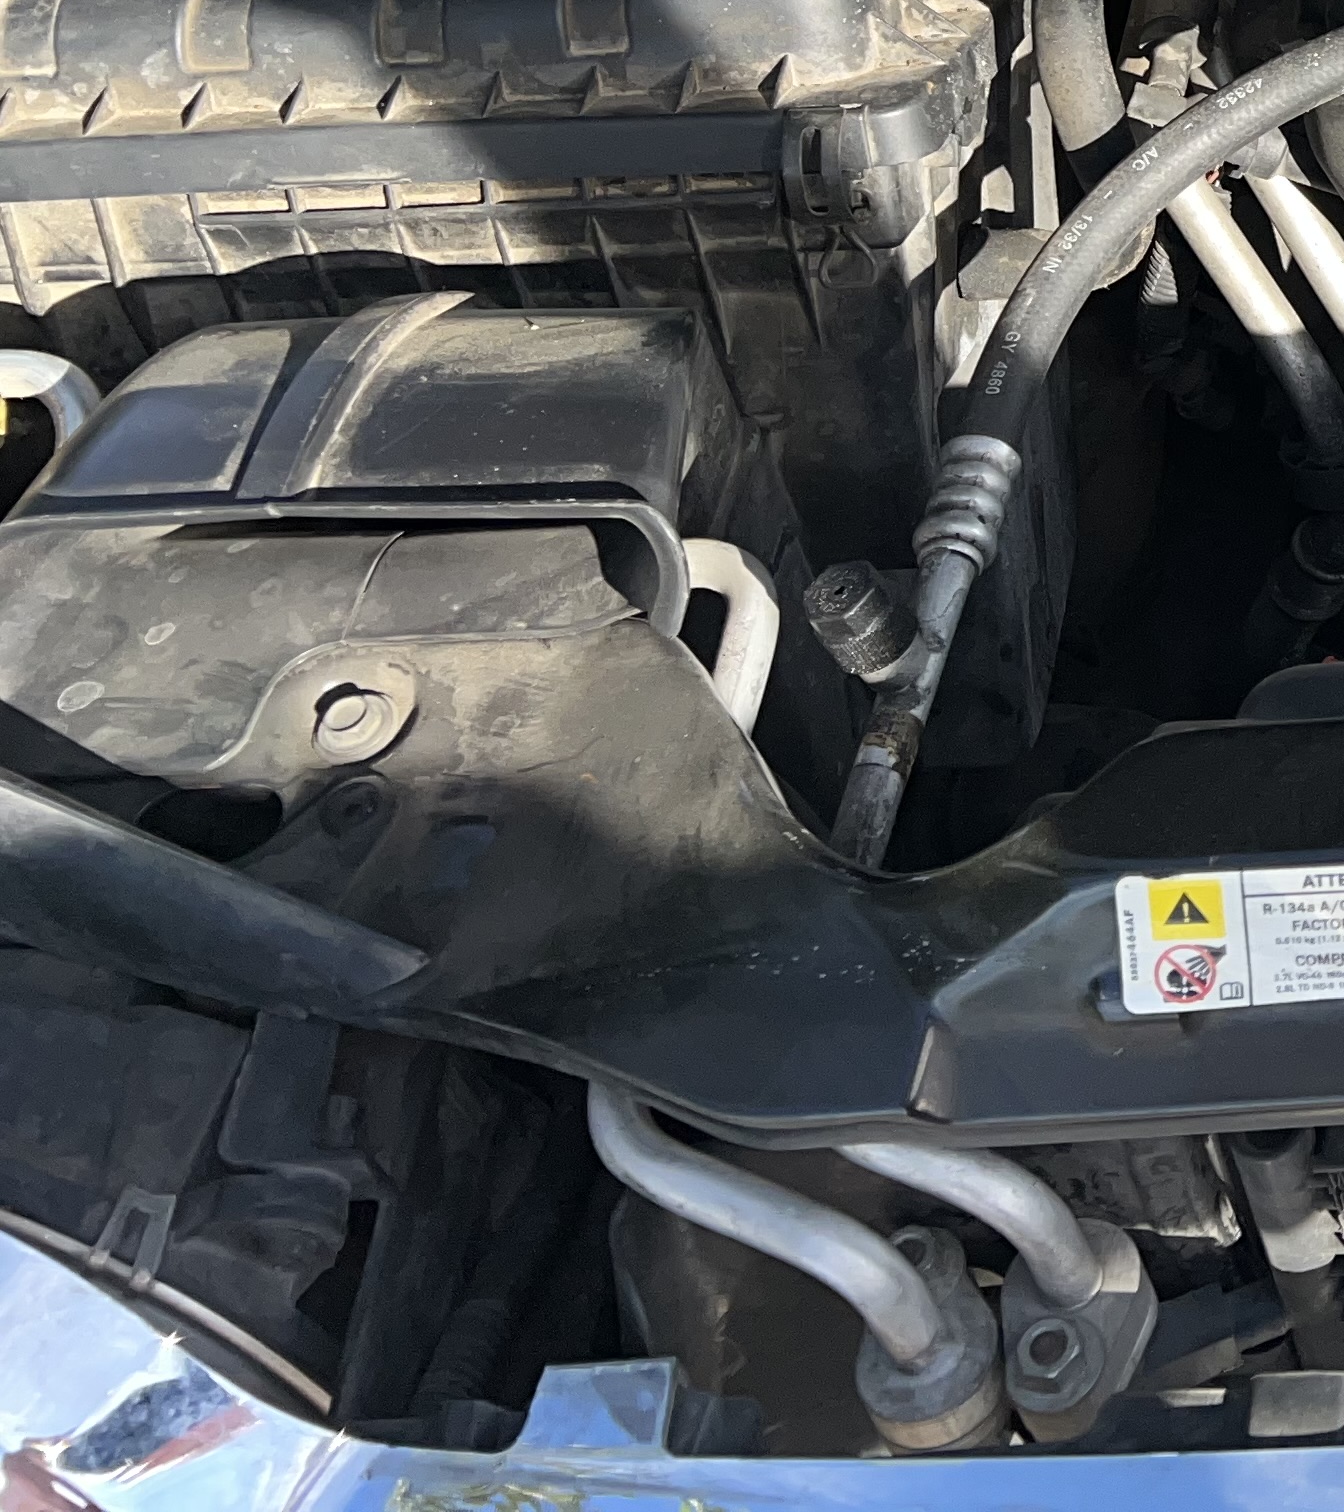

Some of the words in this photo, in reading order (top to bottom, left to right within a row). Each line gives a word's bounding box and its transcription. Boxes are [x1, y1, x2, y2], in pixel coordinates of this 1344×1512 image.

[1131, 146, 1160, 171] A/C
[1058, 213, 1093, 251] 13/32
[1042, 256, 1063, 274] IN
[1001, 331, 1021, 354] GY
[985, 360, 1009, 396] 4860
[1262, 901, 1315, 915] R-134a
